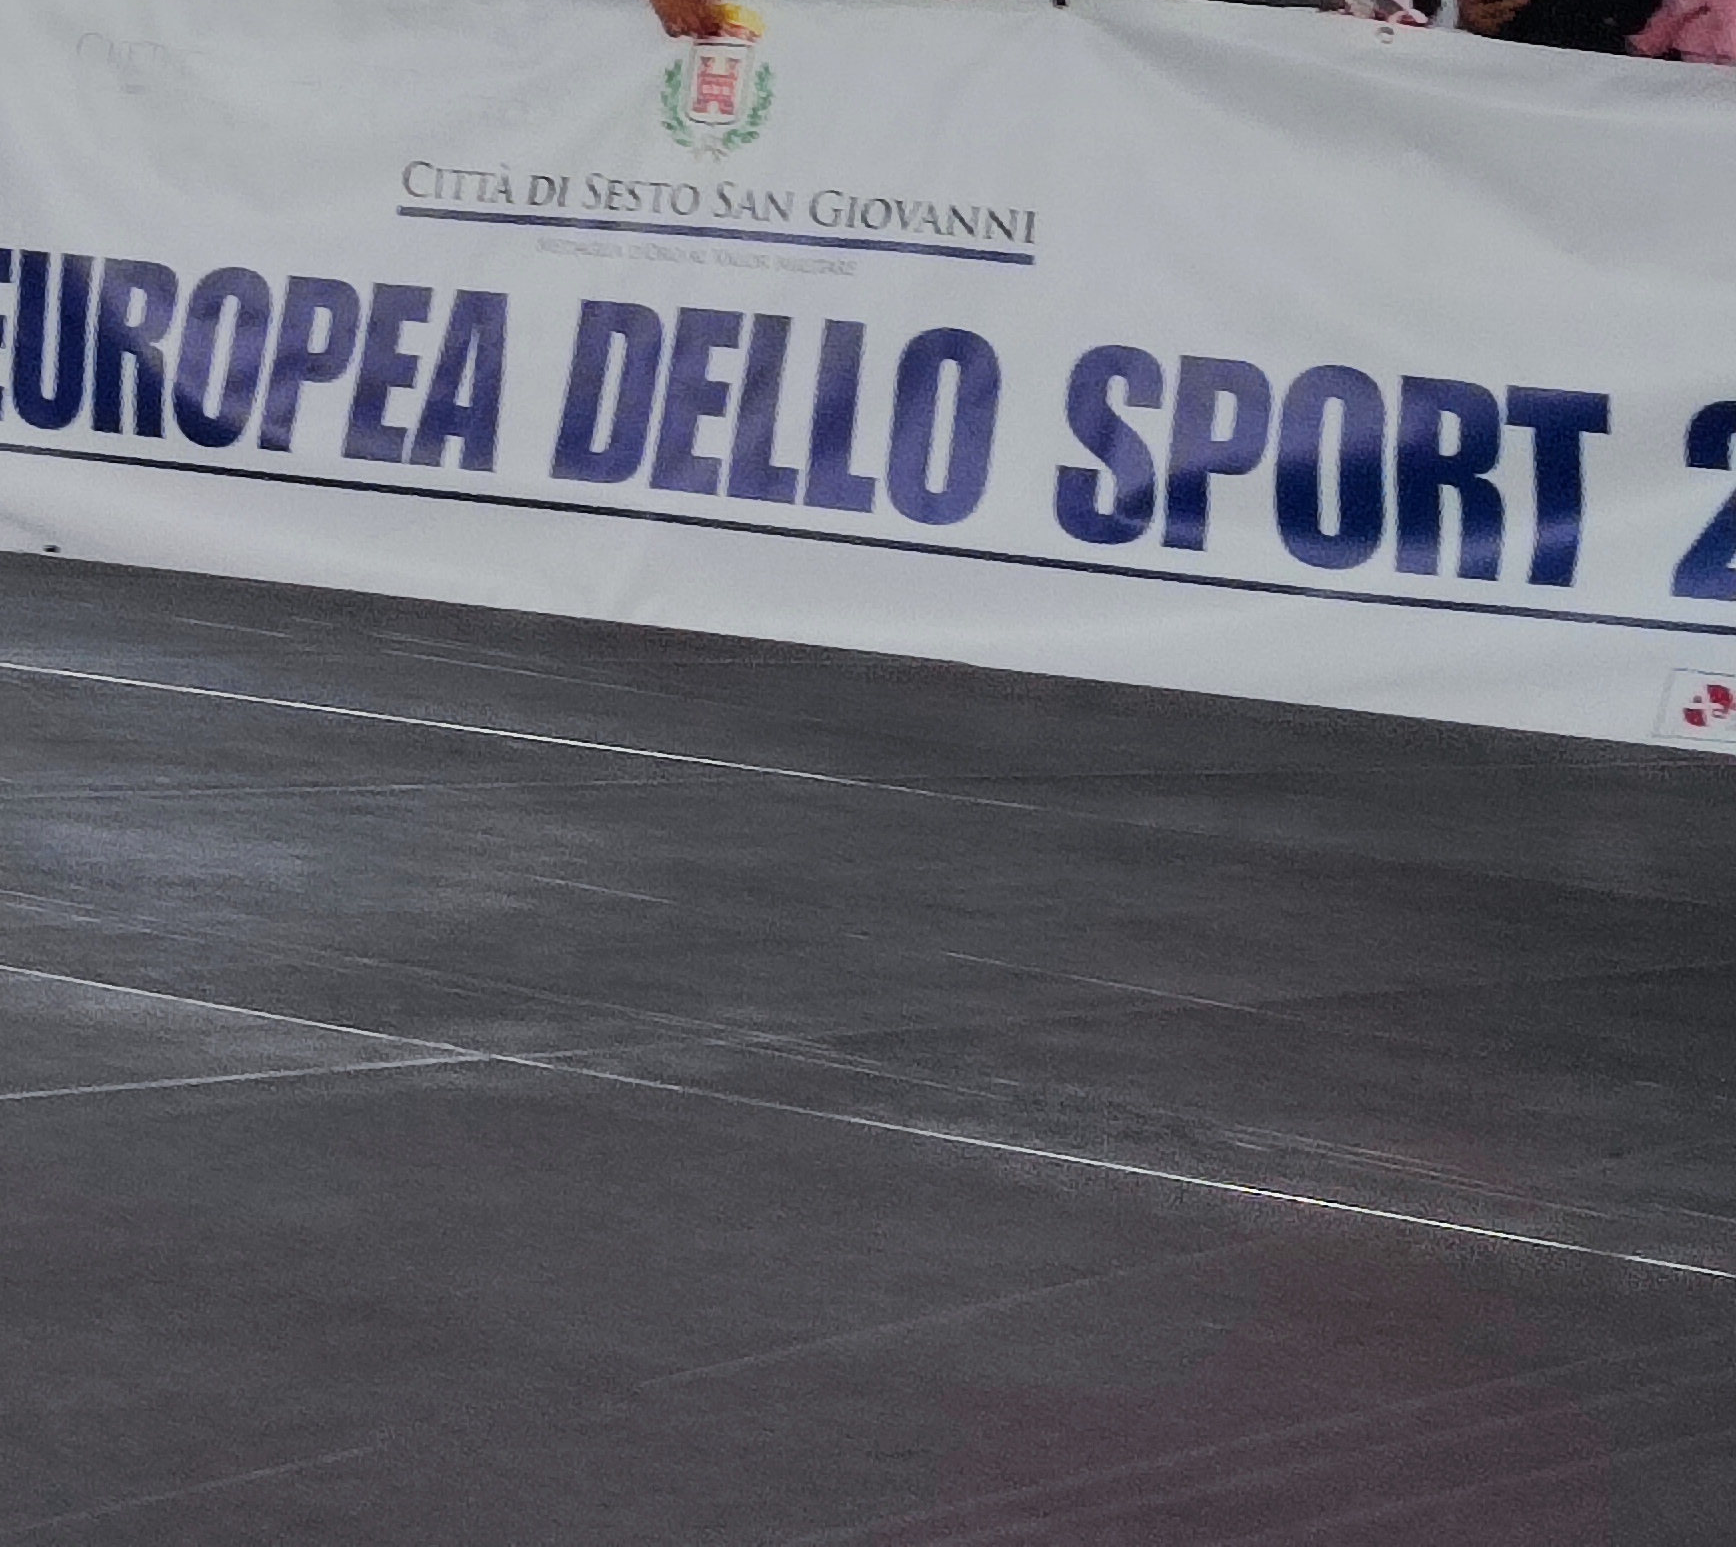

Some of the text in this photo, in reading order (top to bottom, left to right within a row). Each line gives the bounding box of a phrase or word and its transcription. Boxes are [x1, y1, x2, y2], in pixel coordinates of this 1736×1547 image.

[400, 159, 1038, 245] CITTÀ DI SESTO SAN GIOVANNI
[549, 298, 1003, 526] DELLO
[1053, 344, 1611, 588] SPORT
